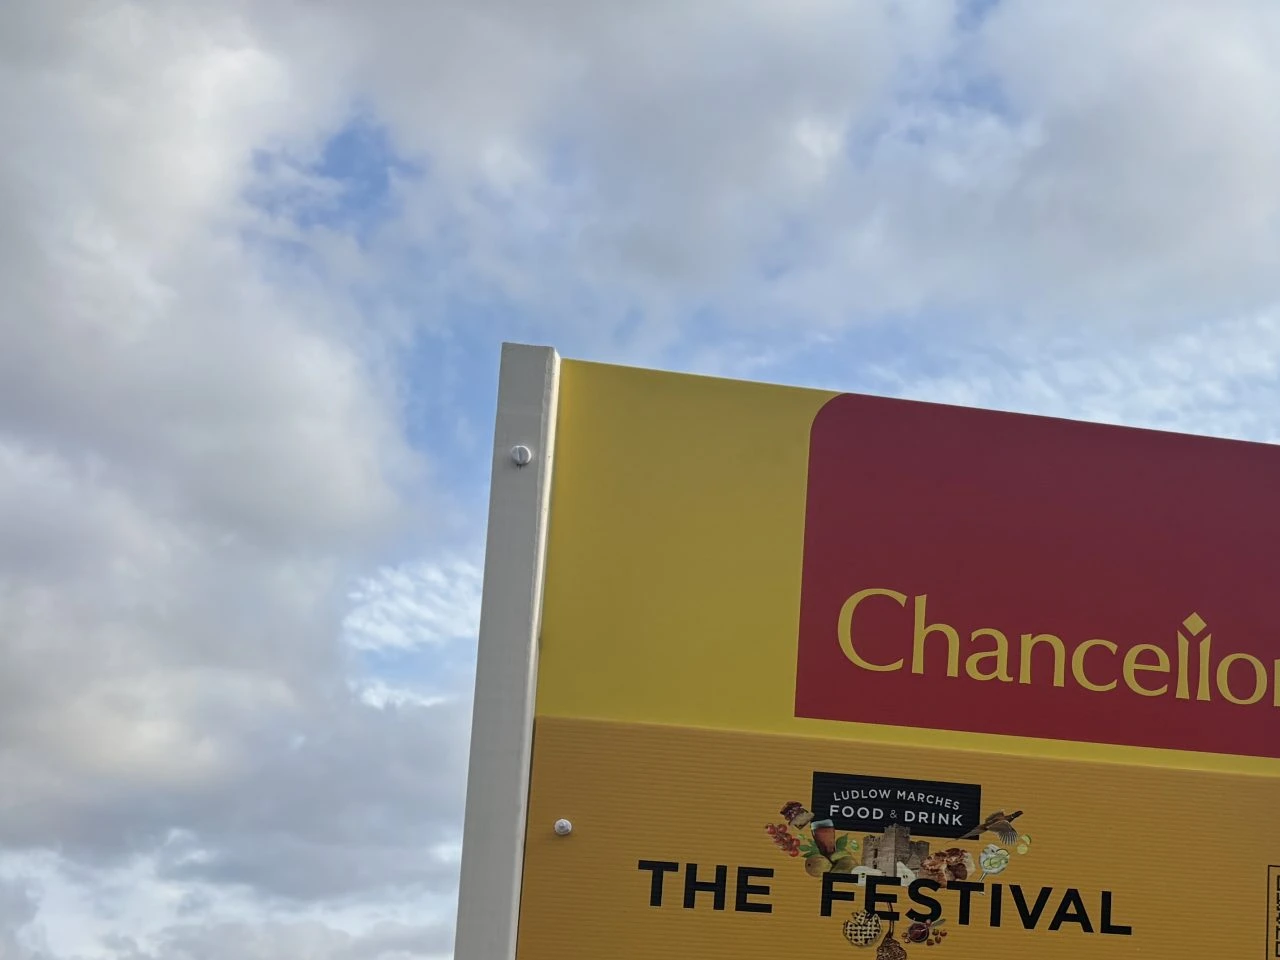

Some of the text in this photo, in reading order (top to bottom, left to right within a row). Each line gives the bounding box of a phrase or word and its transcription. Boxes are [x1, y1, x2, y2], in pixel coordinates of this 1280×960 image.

[833, 789, 960, 811] LUDLOW MARCHES
[829, 804, 963, 826] FOOD & DRINK
[638, 860, 1132, 936] THE FESTIVAL
